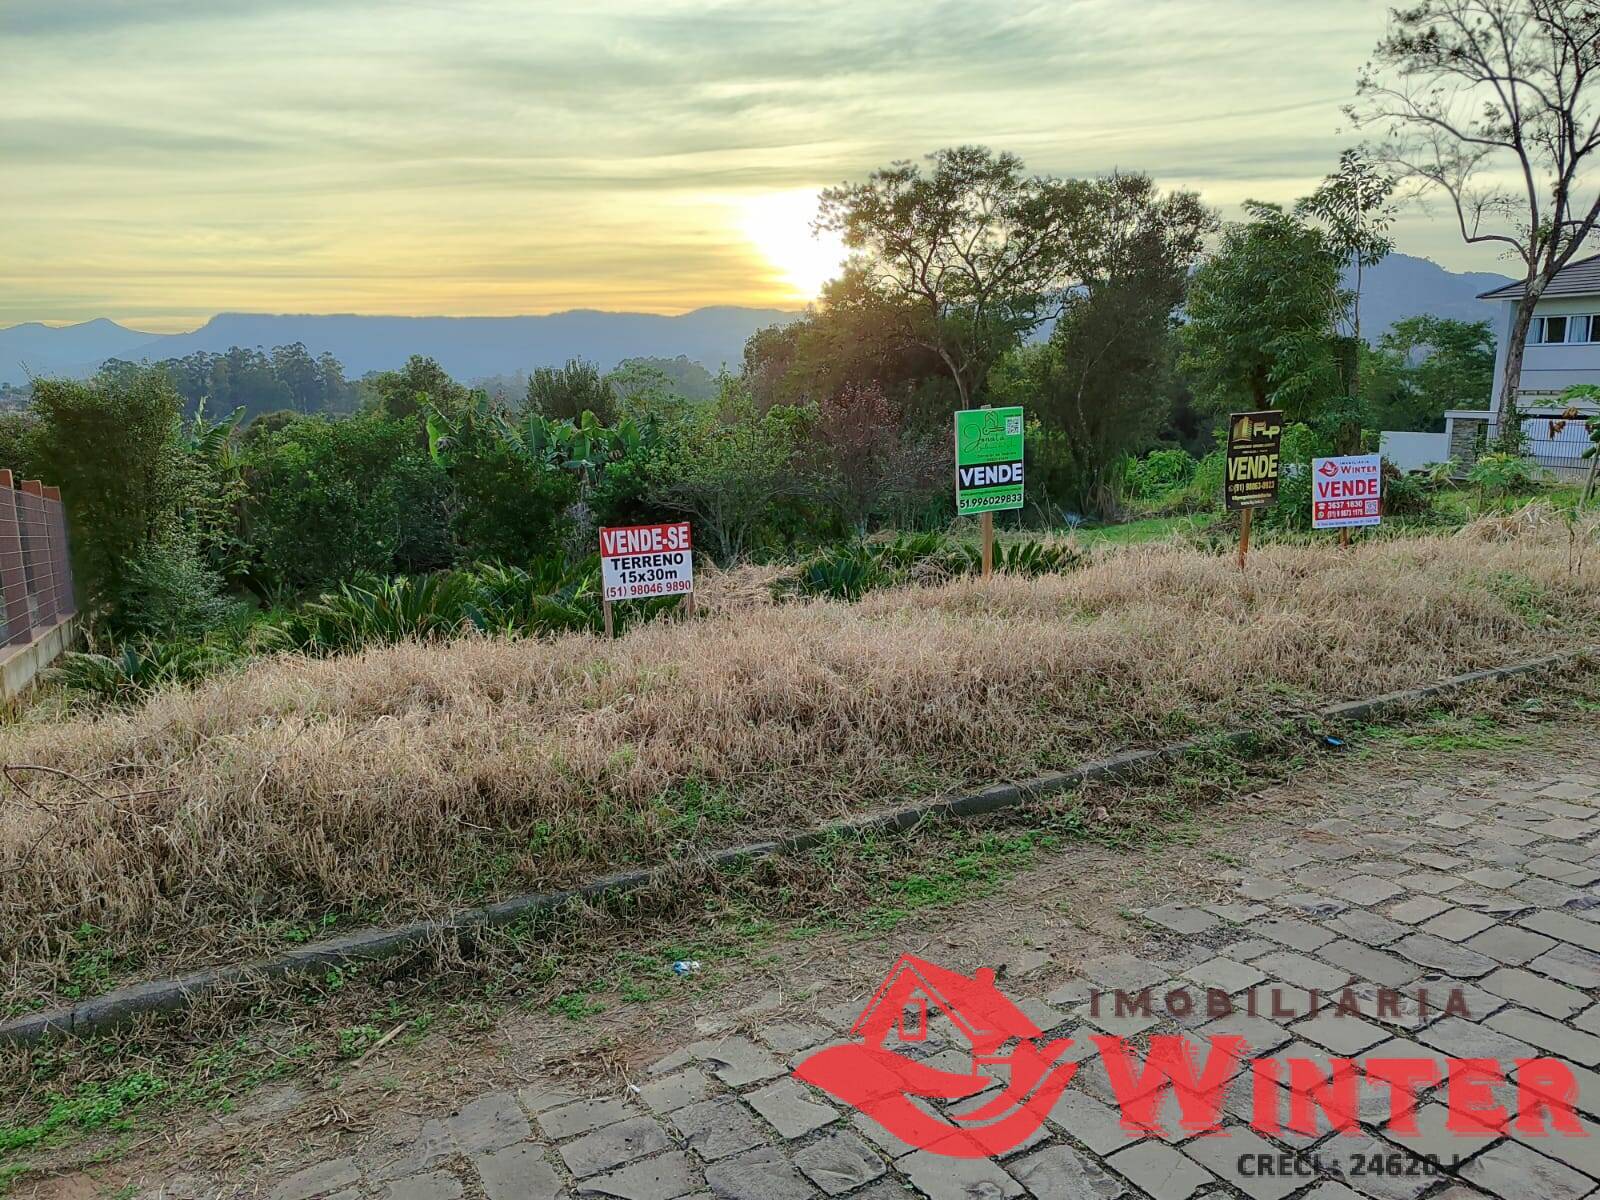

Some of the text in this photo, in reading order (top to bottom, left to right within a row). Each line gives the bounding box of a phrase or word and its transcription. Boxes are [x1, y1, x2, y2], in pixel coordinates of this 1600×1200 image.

[960, 463, 1023, 487] VENDE
[1228, 454, 1278, 480] VENDE
[1341, 466, 1377, 474] WINTER
[1318, 479, 1378, 498] VENDE
[960, 494, 1022, 508] 51.996029833
[603, 526, 689, 554] VENDE-SE
[611, 553, 684, 570] TERRENO
[620, 569, 677, 584] 15x30m
[606, 580, 691, 598] (51) 98046 9890
